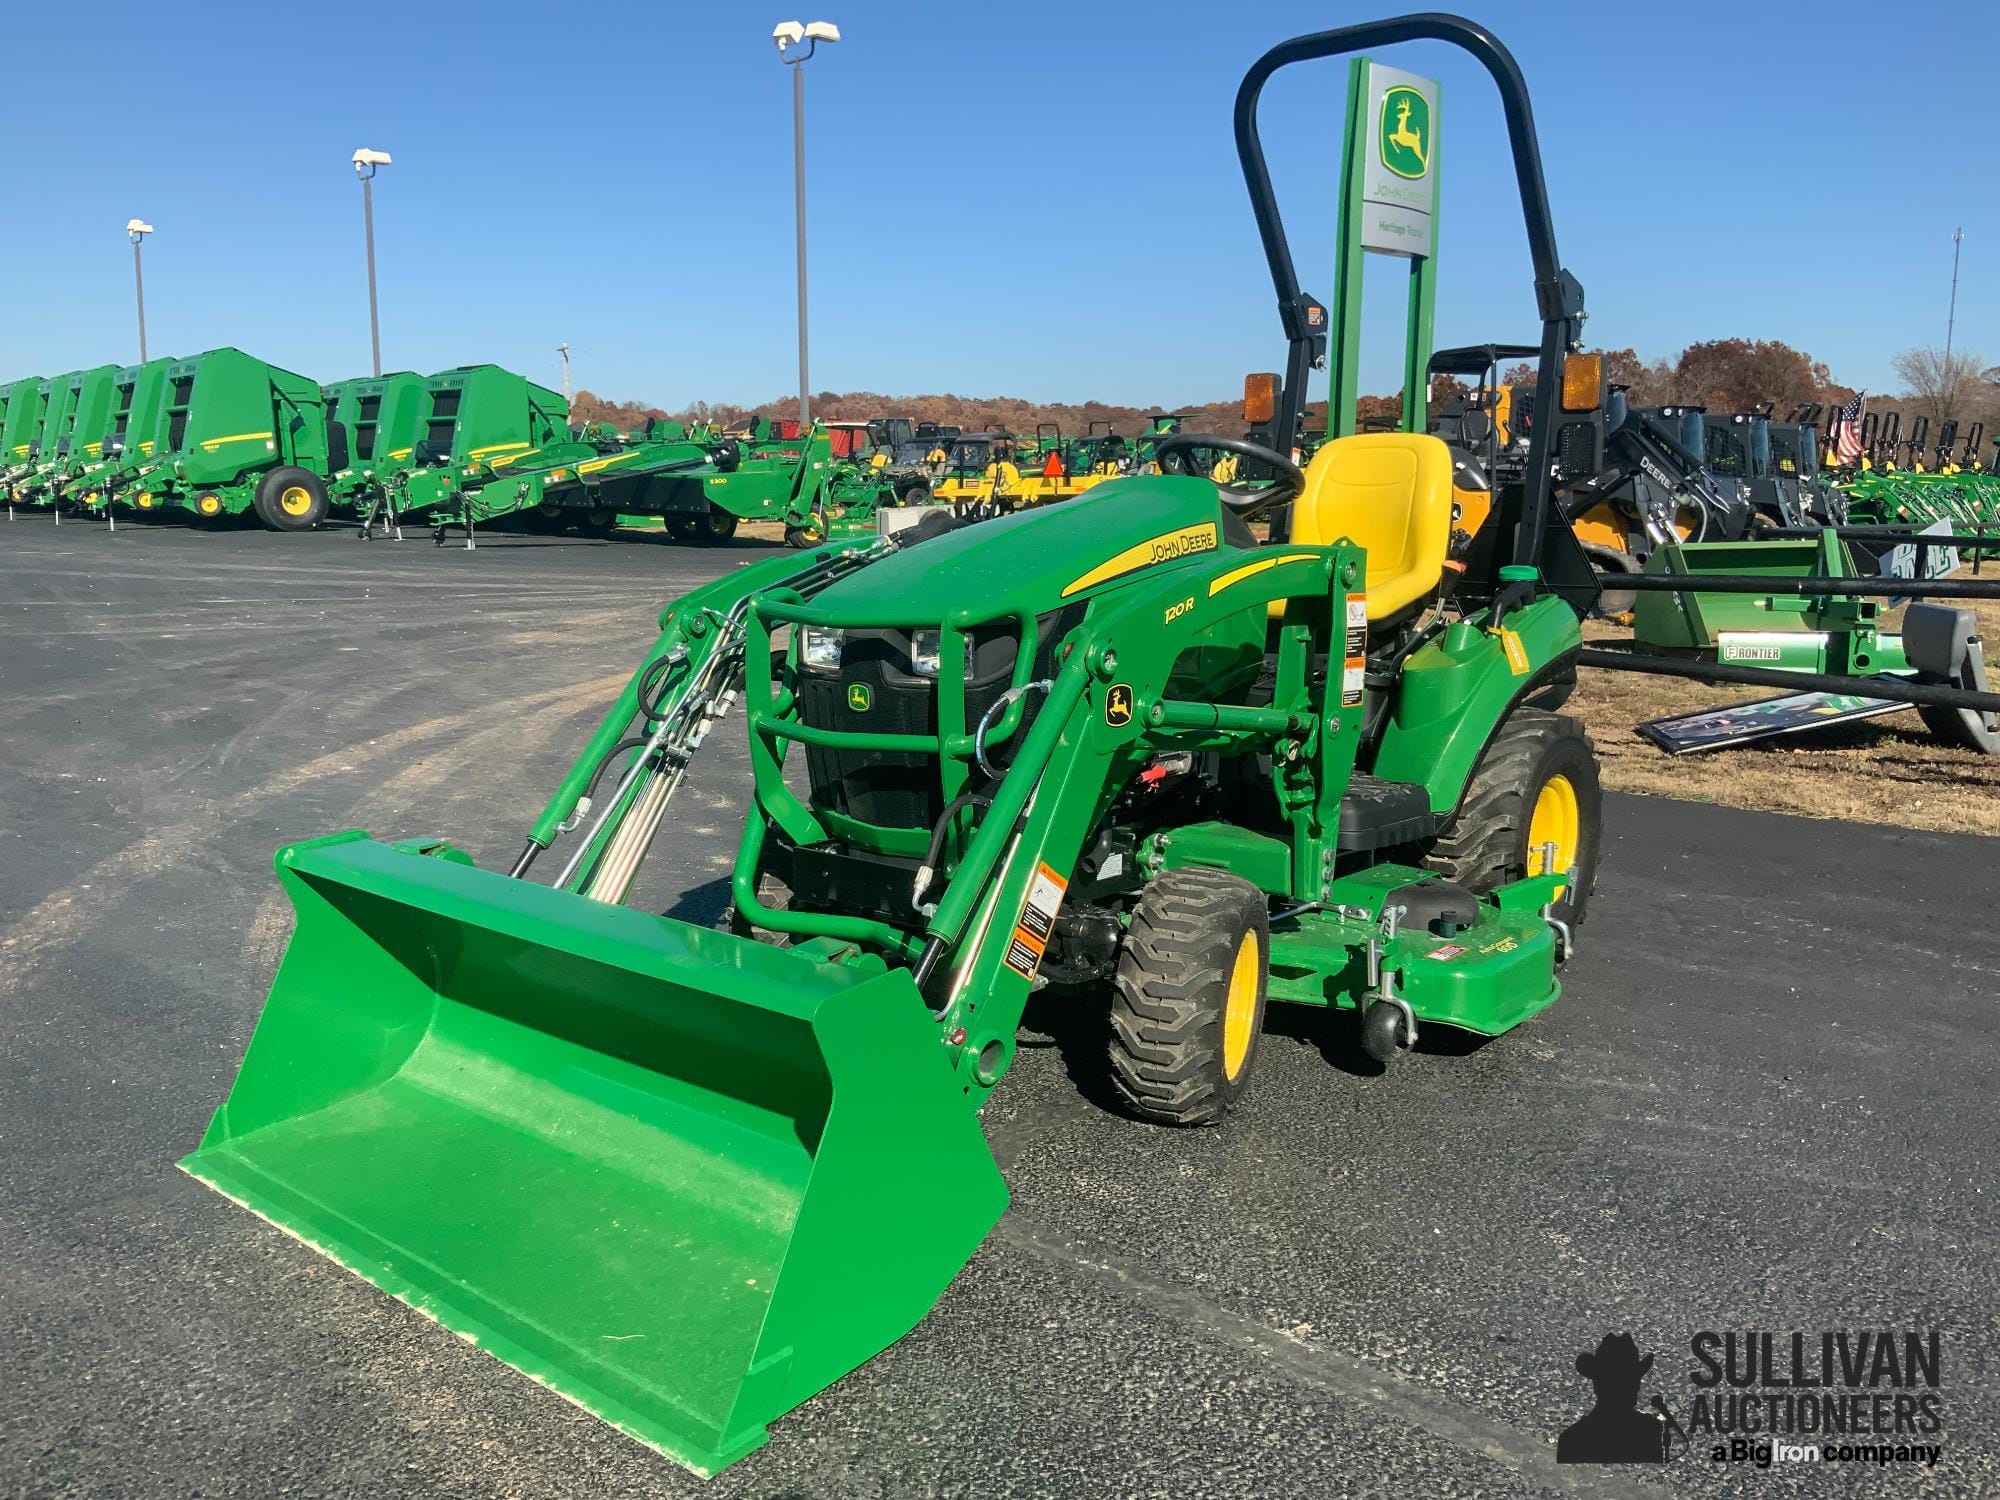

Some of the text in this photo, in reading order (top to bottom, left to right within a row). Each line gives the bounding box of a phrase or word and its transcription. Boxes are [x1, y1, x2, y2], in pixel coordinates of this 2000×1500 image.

[1373, 182, 1402, 198] JOHN
[1378, 220, 1405, 236] Heritage
[1639, 455, 1673, 489] DEERE
[1151, 533, 1214, 562] JOHN DEERE
[1725, 645, 1779, 660] FRONTIER
